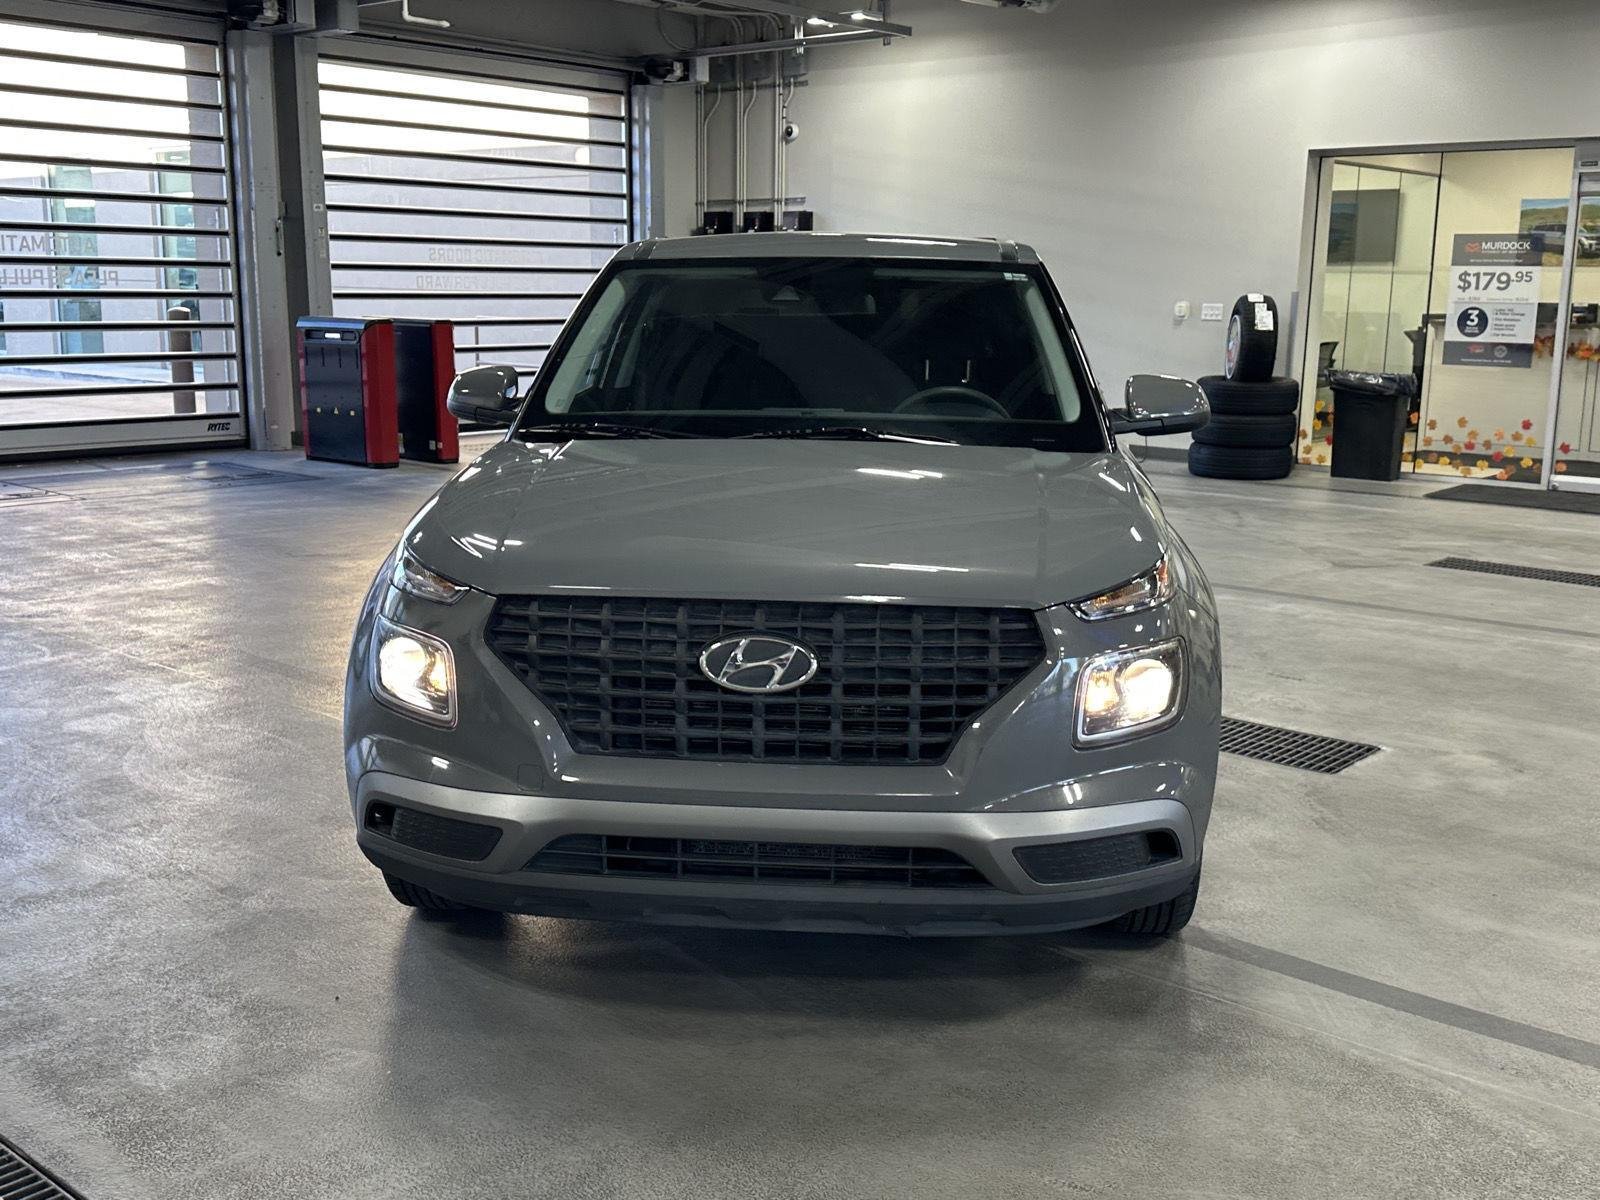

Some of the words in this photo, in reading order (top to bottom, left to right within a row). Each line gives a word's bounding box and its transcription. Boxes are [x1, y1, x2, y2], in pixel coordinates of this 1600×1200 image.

[1481, 241, 1531, 250] MURDOCK
[1457, 270, 1533, 293] $179.95
[1466, 310, 1480, 327] 3
